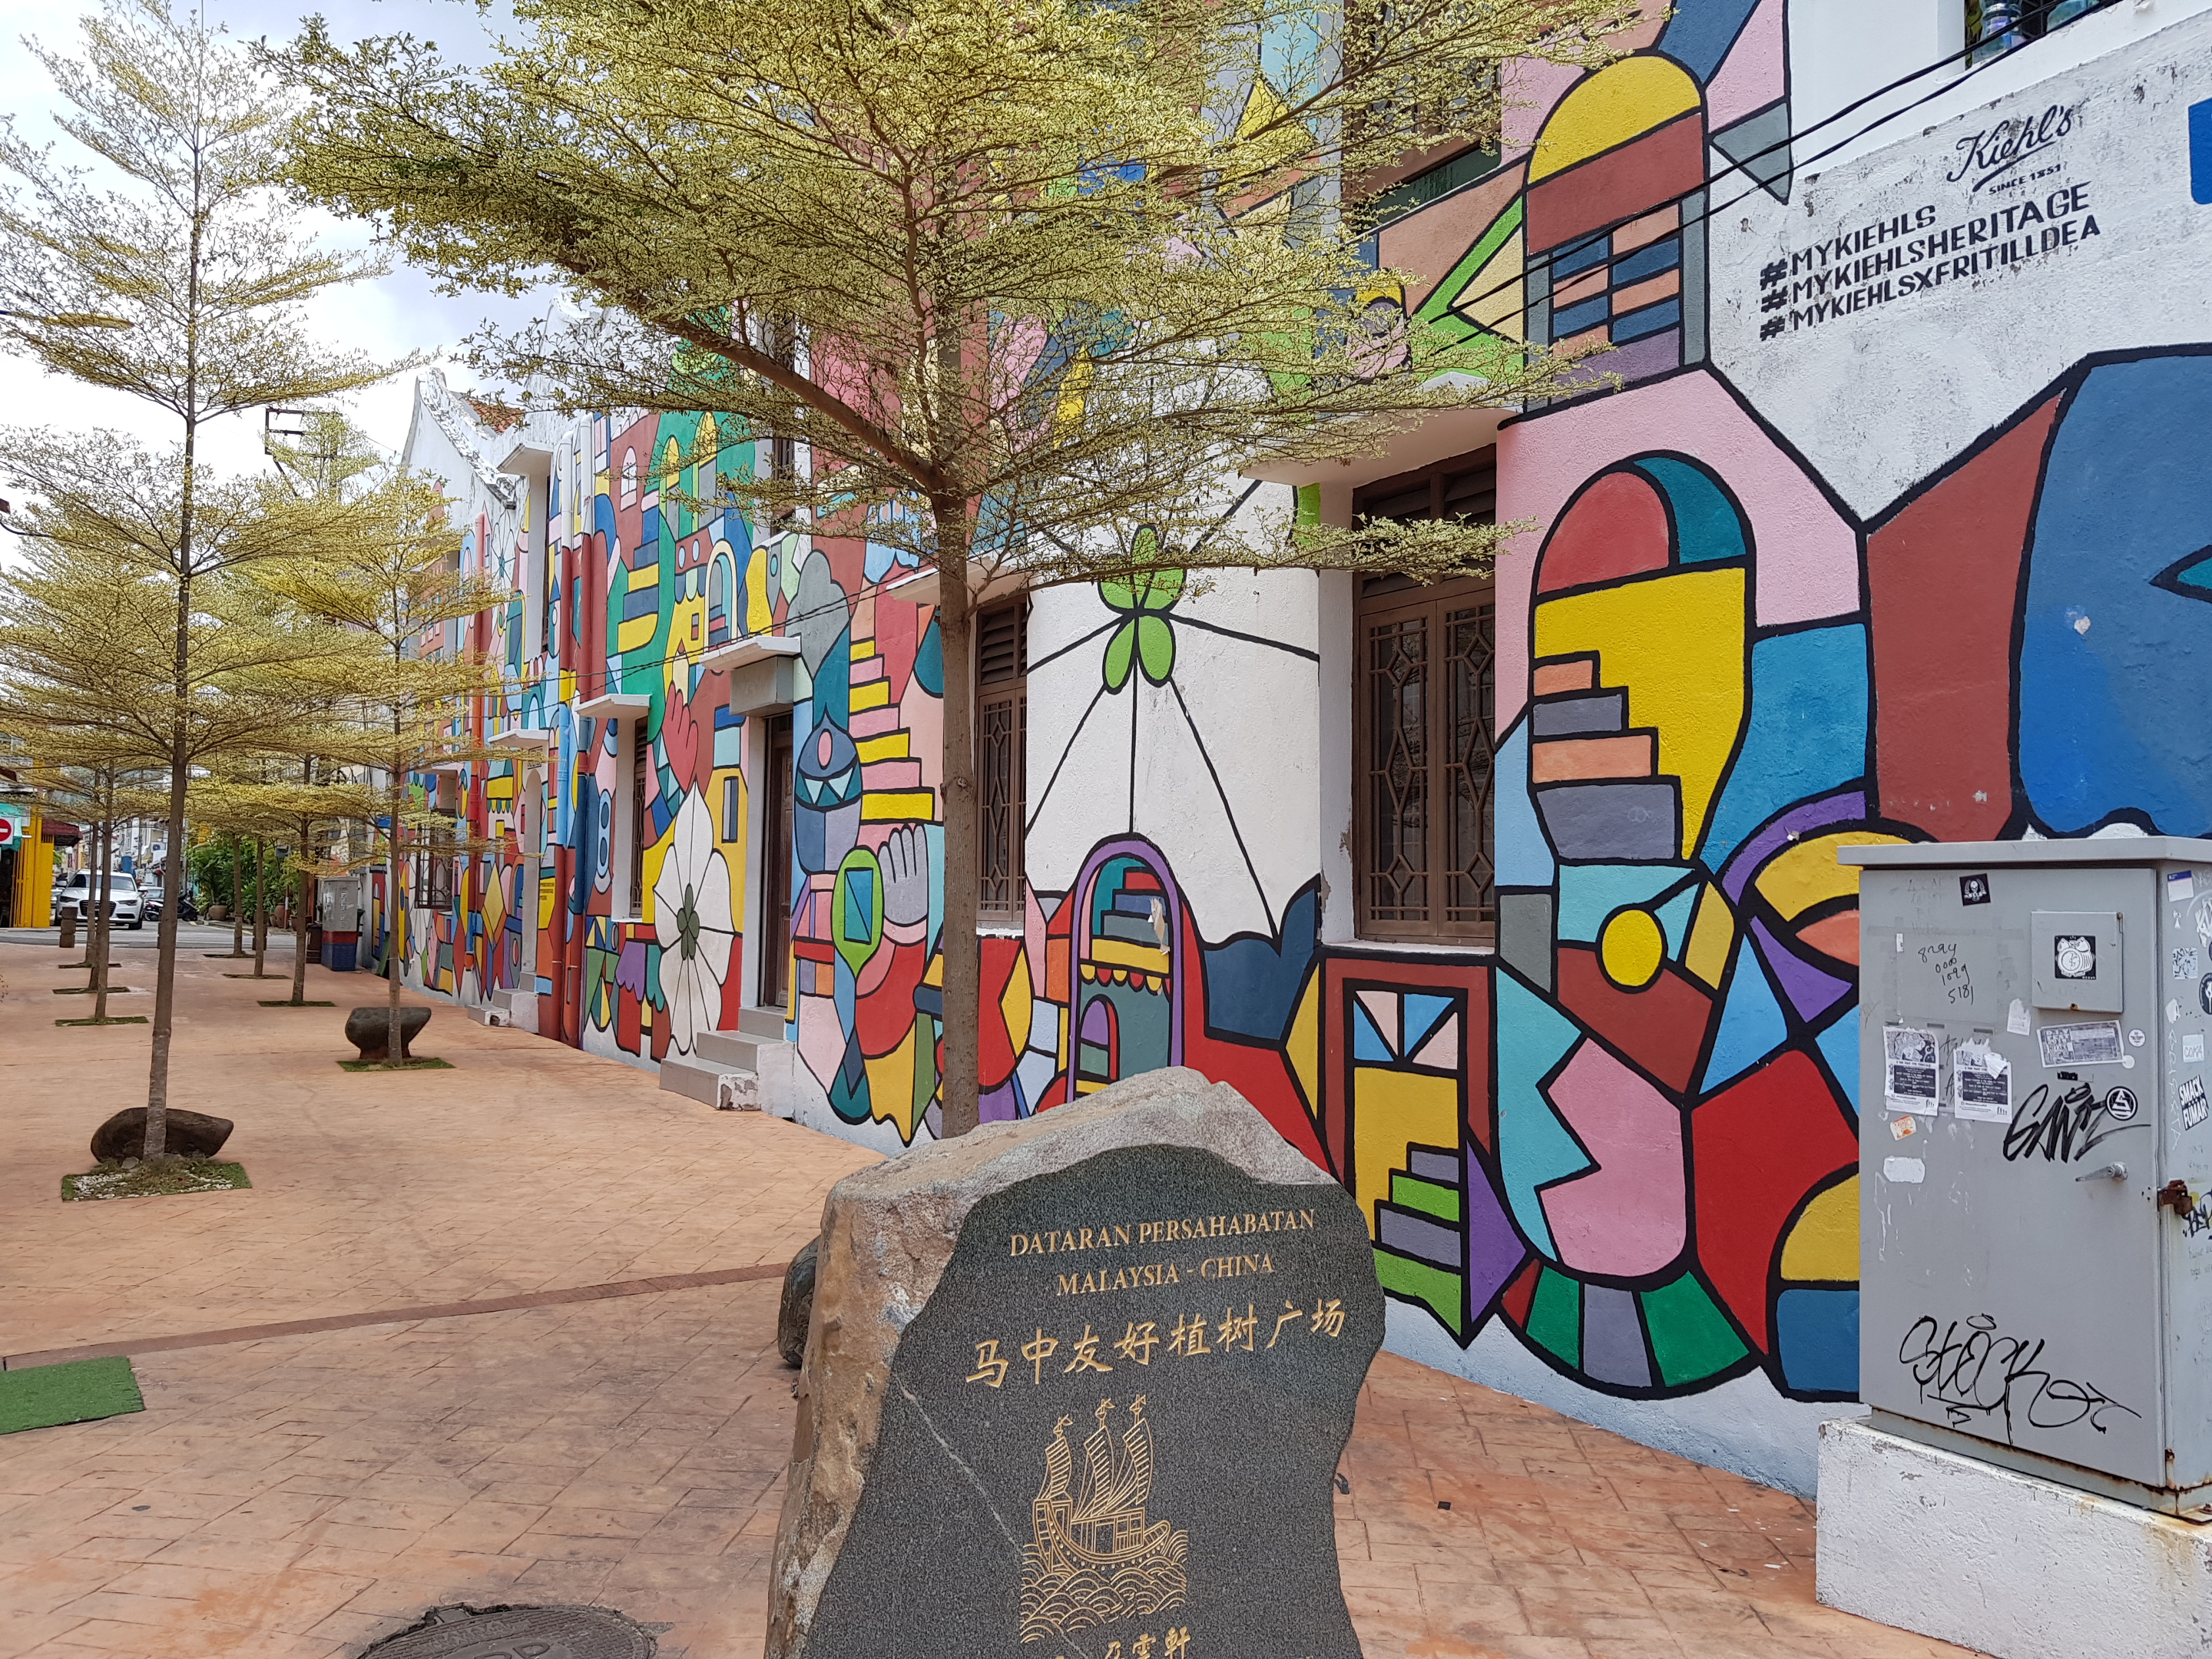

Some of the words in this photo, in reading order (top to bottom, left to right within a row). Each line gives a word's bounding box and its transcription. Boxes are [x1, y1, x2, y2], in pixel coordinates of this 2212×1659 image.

[1946, 104, 2074, 183] Kiehl's
[1988, 176, 2026, 195] SINCE
[2029, 164, 2061, 181] 1851
[1760, 180, 2091, 313] #MYKIEHLSHERITAGE
[1760, 204, 1936, 291] #MYKIEHLS
[2179, 1075, 2204, 1106] SMACK
[1009, 1224, 1131, 1257] DATARAN
[1138, 1208, 1315, 1243] PERSAHABATAN
[1057, 1262, 1181, 1296] MALAYSIA
[1200, 1253, 1275, 1280] CHINA
[965, 1297, 1346, 1389] 马中友好植树广场
